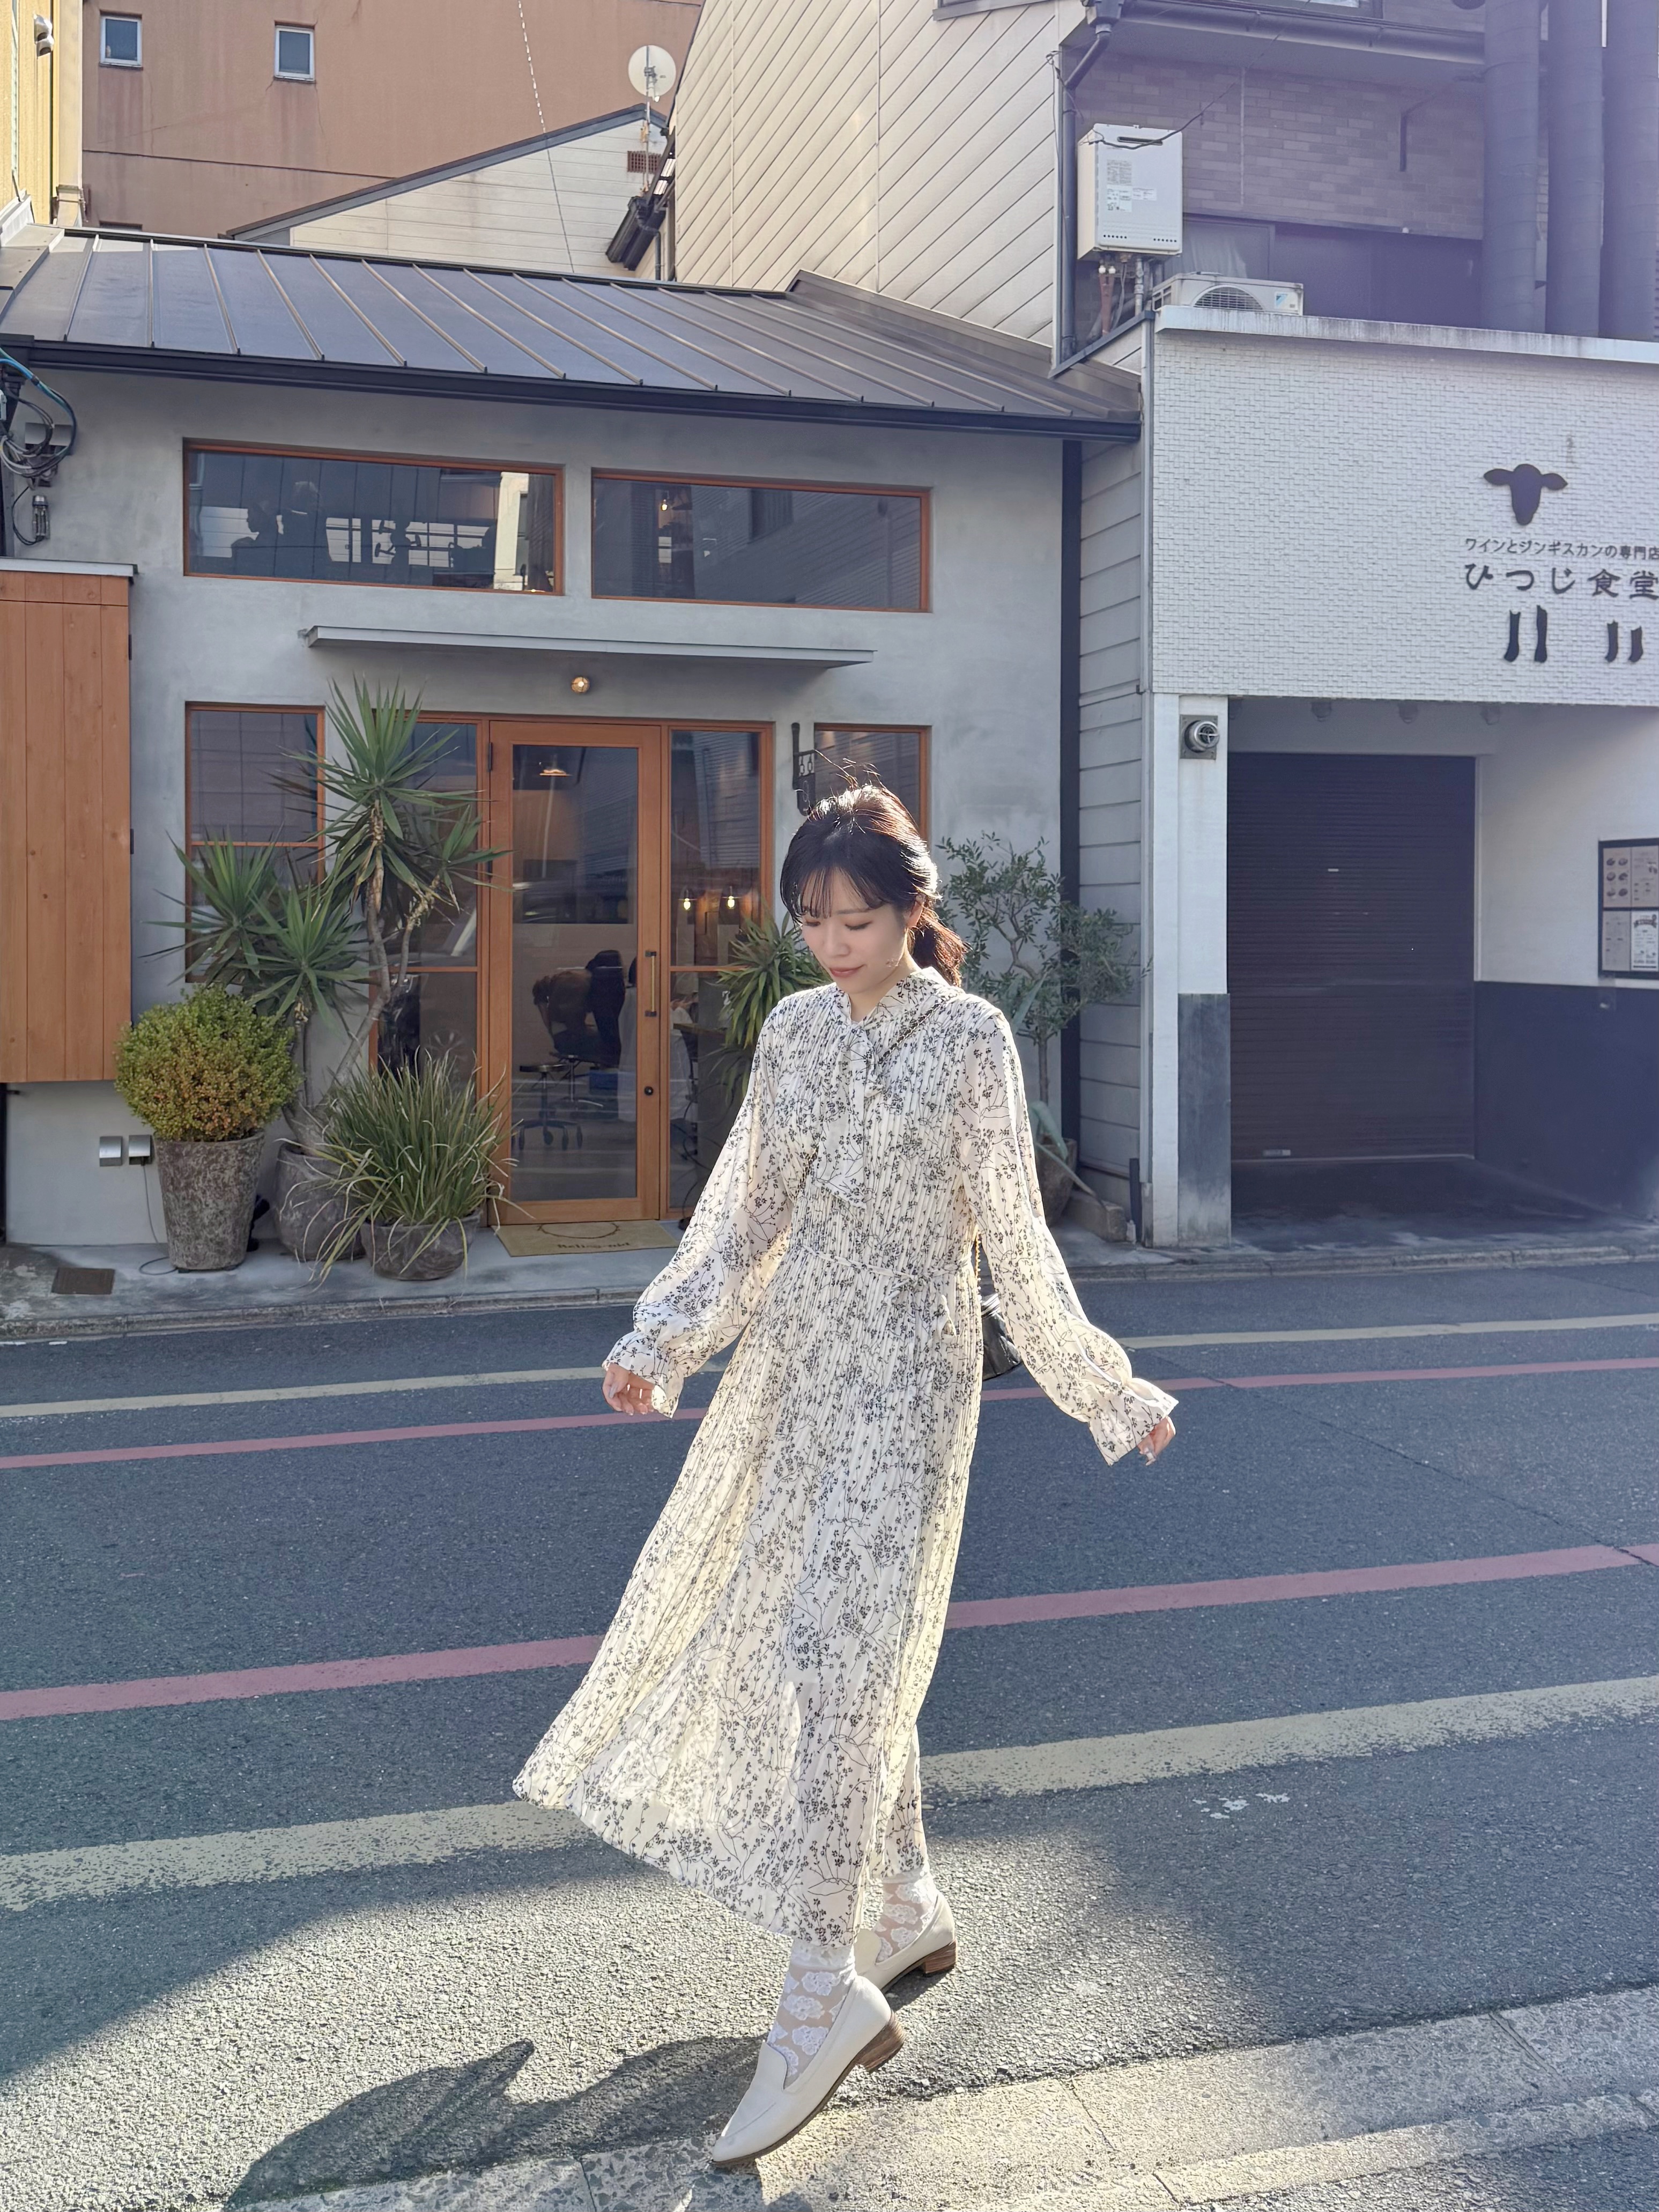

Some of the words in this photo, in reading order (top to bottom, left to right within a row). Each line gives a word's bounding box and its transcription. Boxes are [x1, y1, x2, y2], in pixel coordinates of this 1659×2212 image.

[1465, 538, 1659, 560] ワインとジンギスカンの専門店
[1465, 564, 1659, 600] ひつじ食堂
